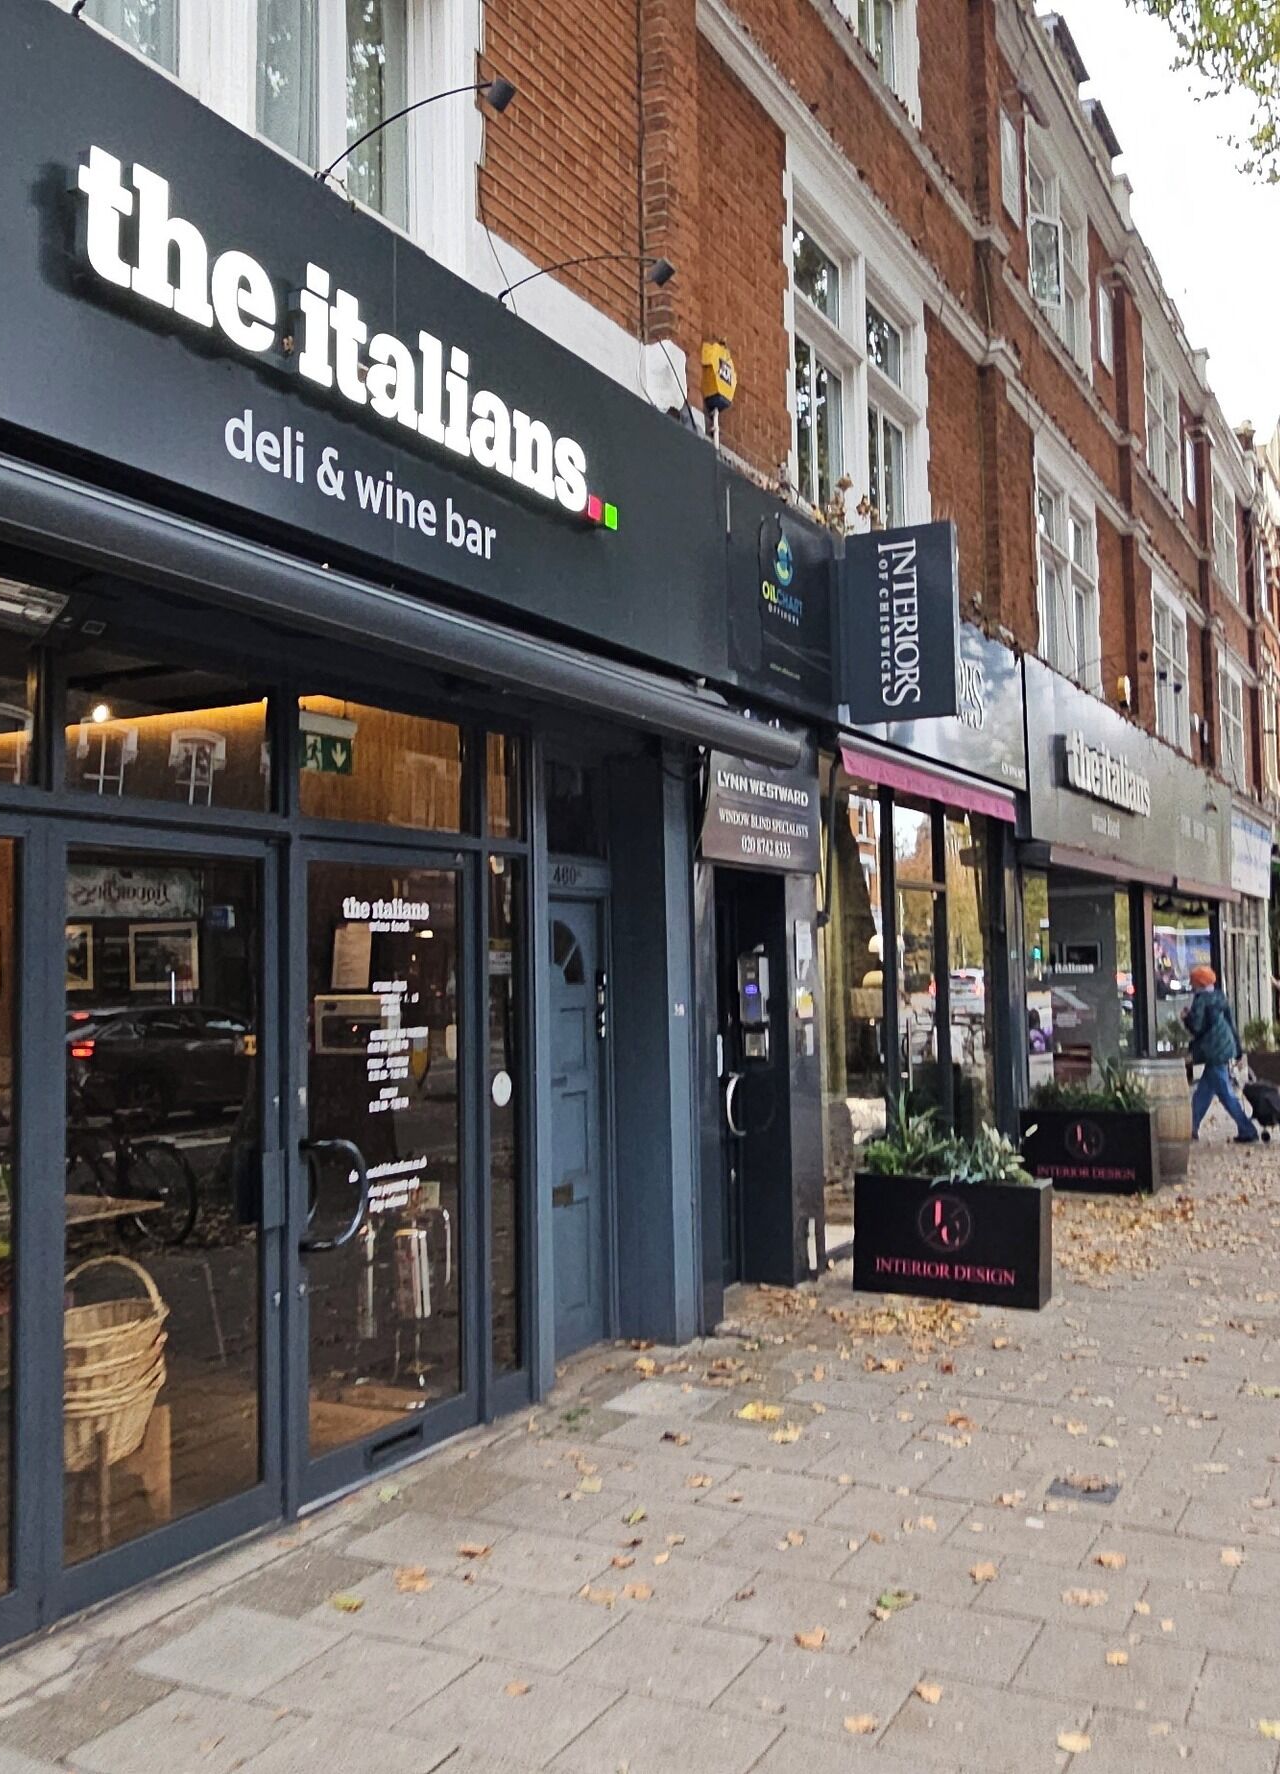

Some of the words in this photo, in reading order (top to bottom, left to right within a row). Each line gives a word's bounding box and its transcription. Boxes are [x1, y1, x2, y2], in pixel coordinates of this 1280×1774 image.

[77, 144, 277, 352] the
[298, 261, 588, 514] italians
[224, 408, 305, 484] deli
[316, 446, 346, 501] &
[354, 471, 437, 537] wine
[445, 512, 497, 560] bar
[878, 558, 889, 581] OF
[761, 580, 803, 616] OILCHART
[877, 538, 921, 707] INTERIORS
[878, 587, 892, 684] CHISWICK
[717, 769, 748, 792] LYNN
[749, 778, 809, 807] WESTWARD
[1065, 728, 1101, 796] the
[1101, 741, 1151, 818] italians
[719, 807, 750, 827] WINDOW
[750, 813, 772, 832] BLIND
[771, 817, 809, 839] SPECIALISTS
[741, 834, 755, 854] 020
[756, 838, 774, 857] 8742
[774, 841, 791, 859] 8333
[342, 896, 370, 919] the
[371, 897, 430, 920] italians
[1036, 1165, 1090, 1179] INTERIOR
[1092, 1166, 1136, 1181] DESIGN
[875, 1256, 950, 1279] INTERIOR
[952, 1264, 1016, 1287] DESIGN
